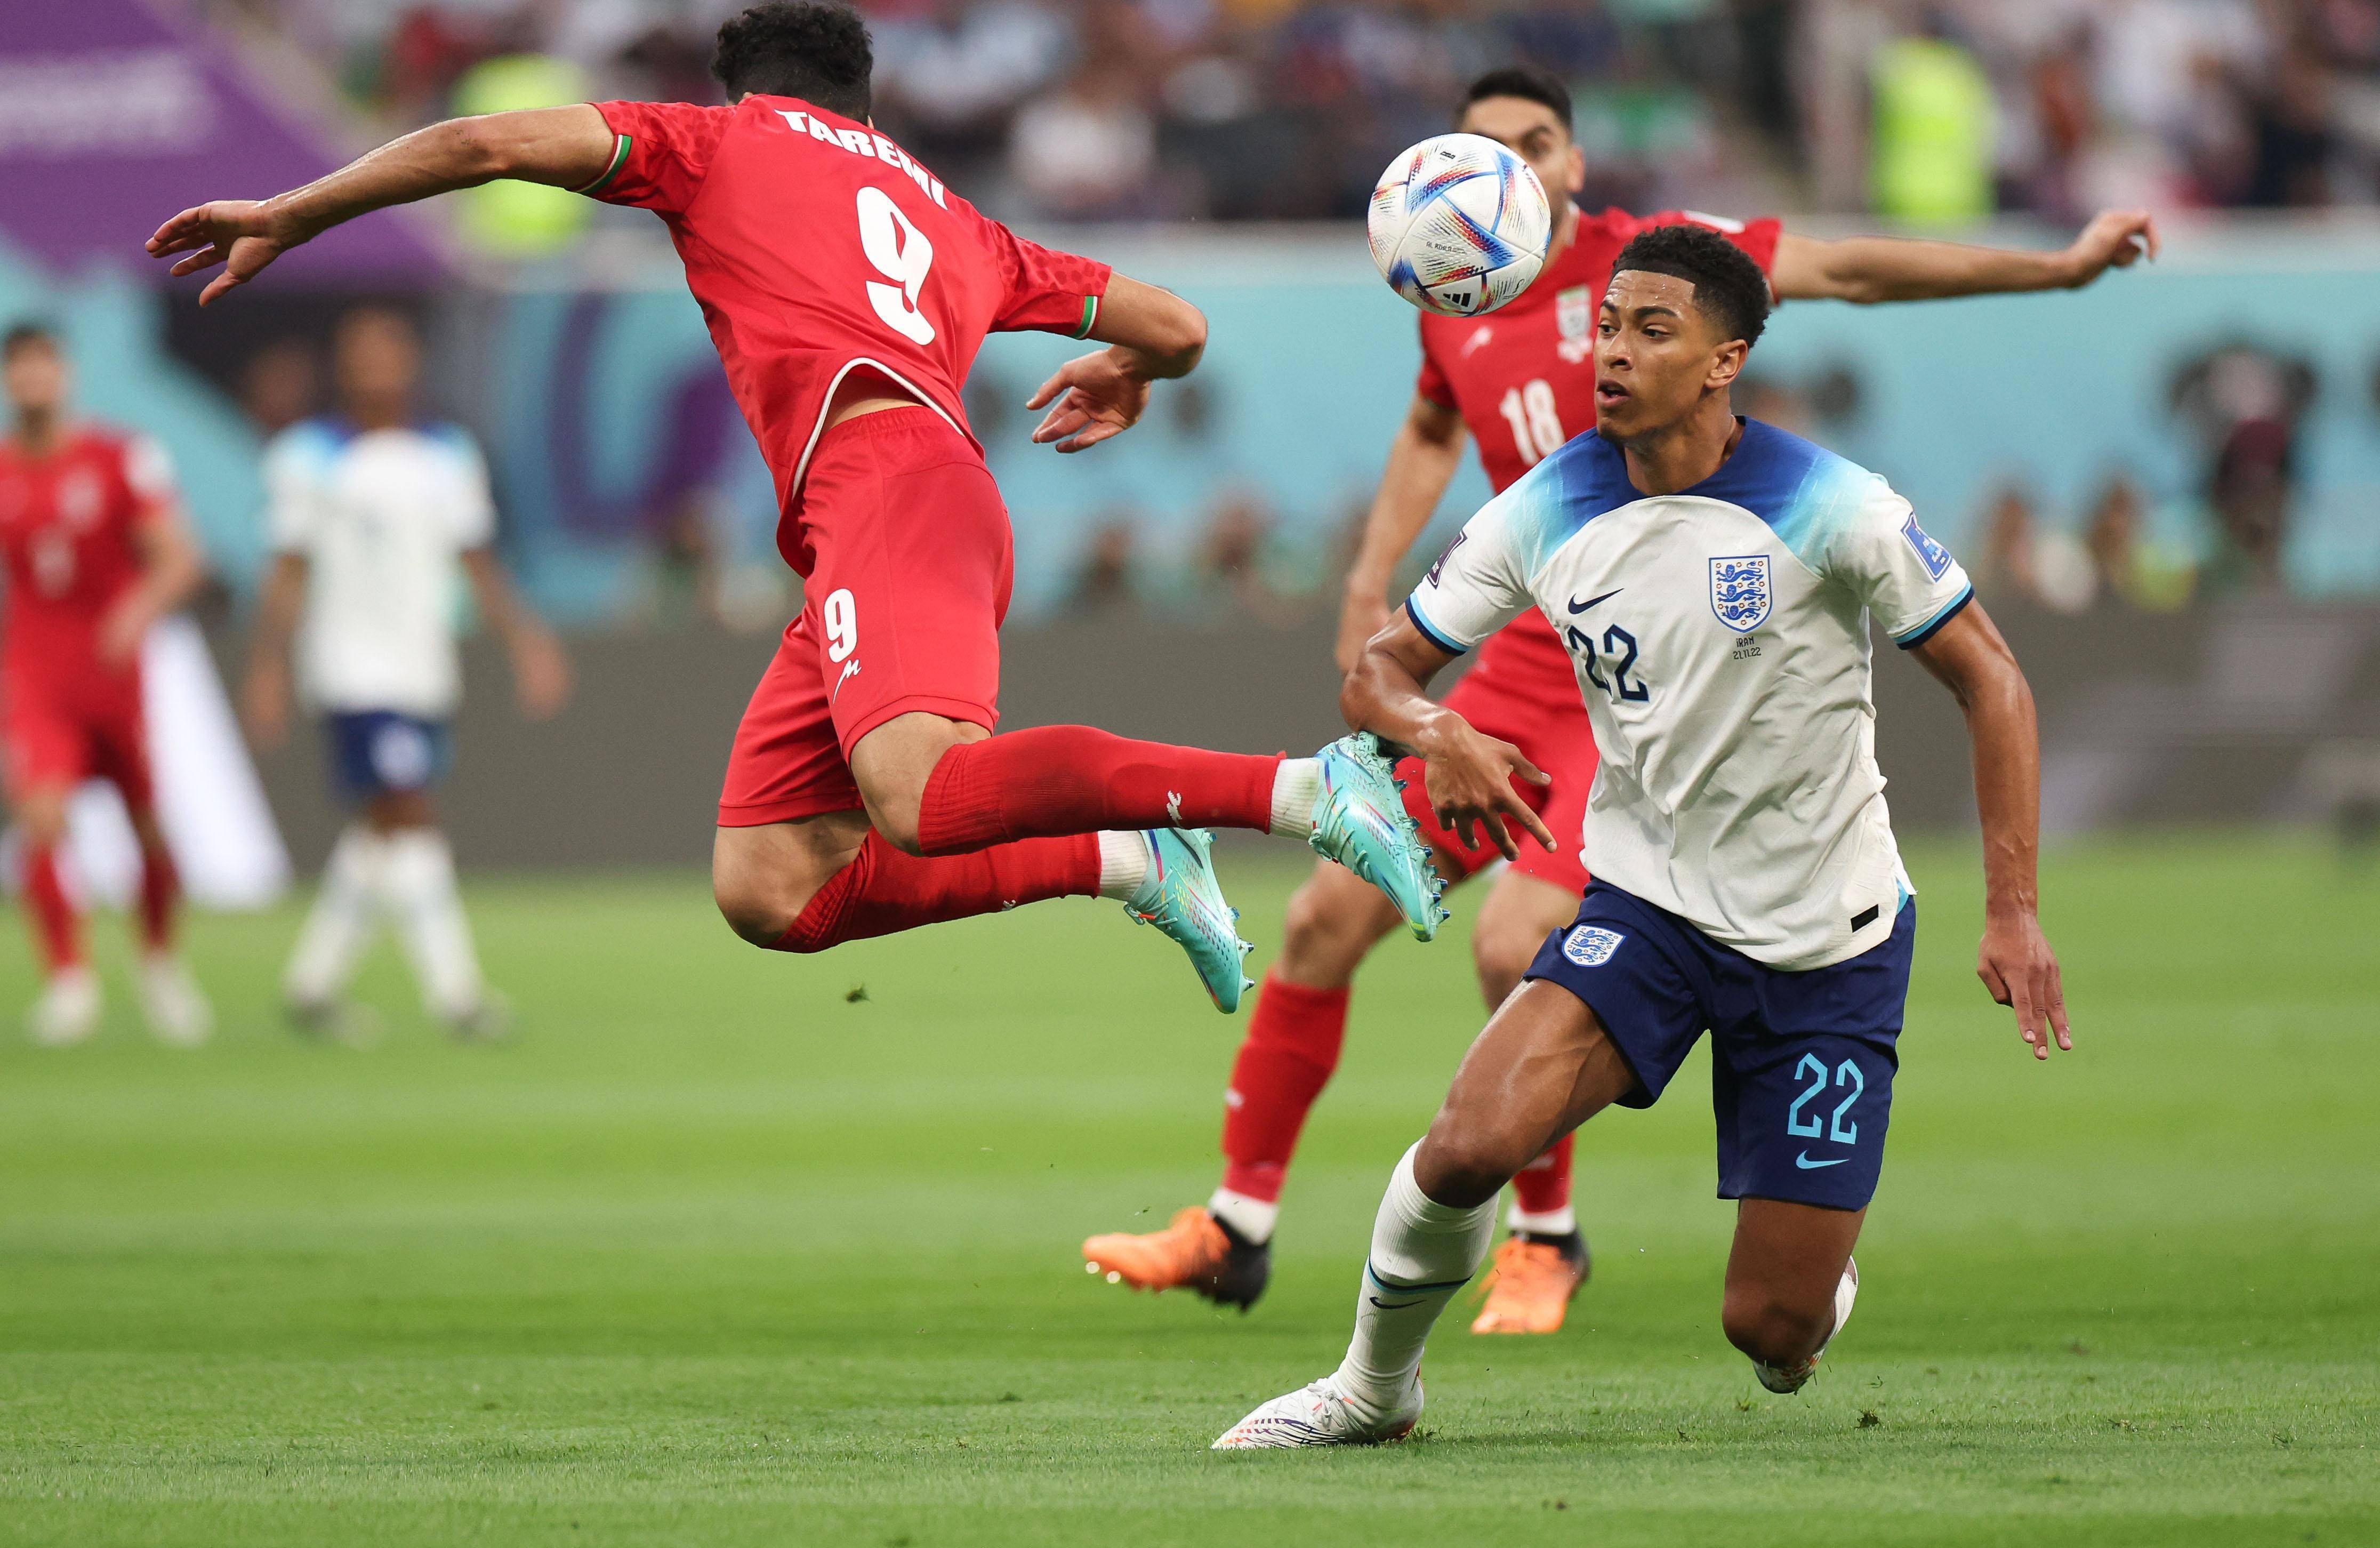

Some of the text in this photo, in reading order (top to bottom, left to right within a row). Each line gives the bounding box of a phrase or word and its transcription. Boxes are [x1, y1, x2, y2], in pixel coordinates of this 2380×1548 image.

[774, 109, 948, 211] TAREMI
[856, 186, 936, 346] 9
[1499, 378, 1566, 466] 18
[824, 588, 858, 663] 9
[1566, 622, 1650, 703] 22
[1787, 1052, 1863, 1145] 22
